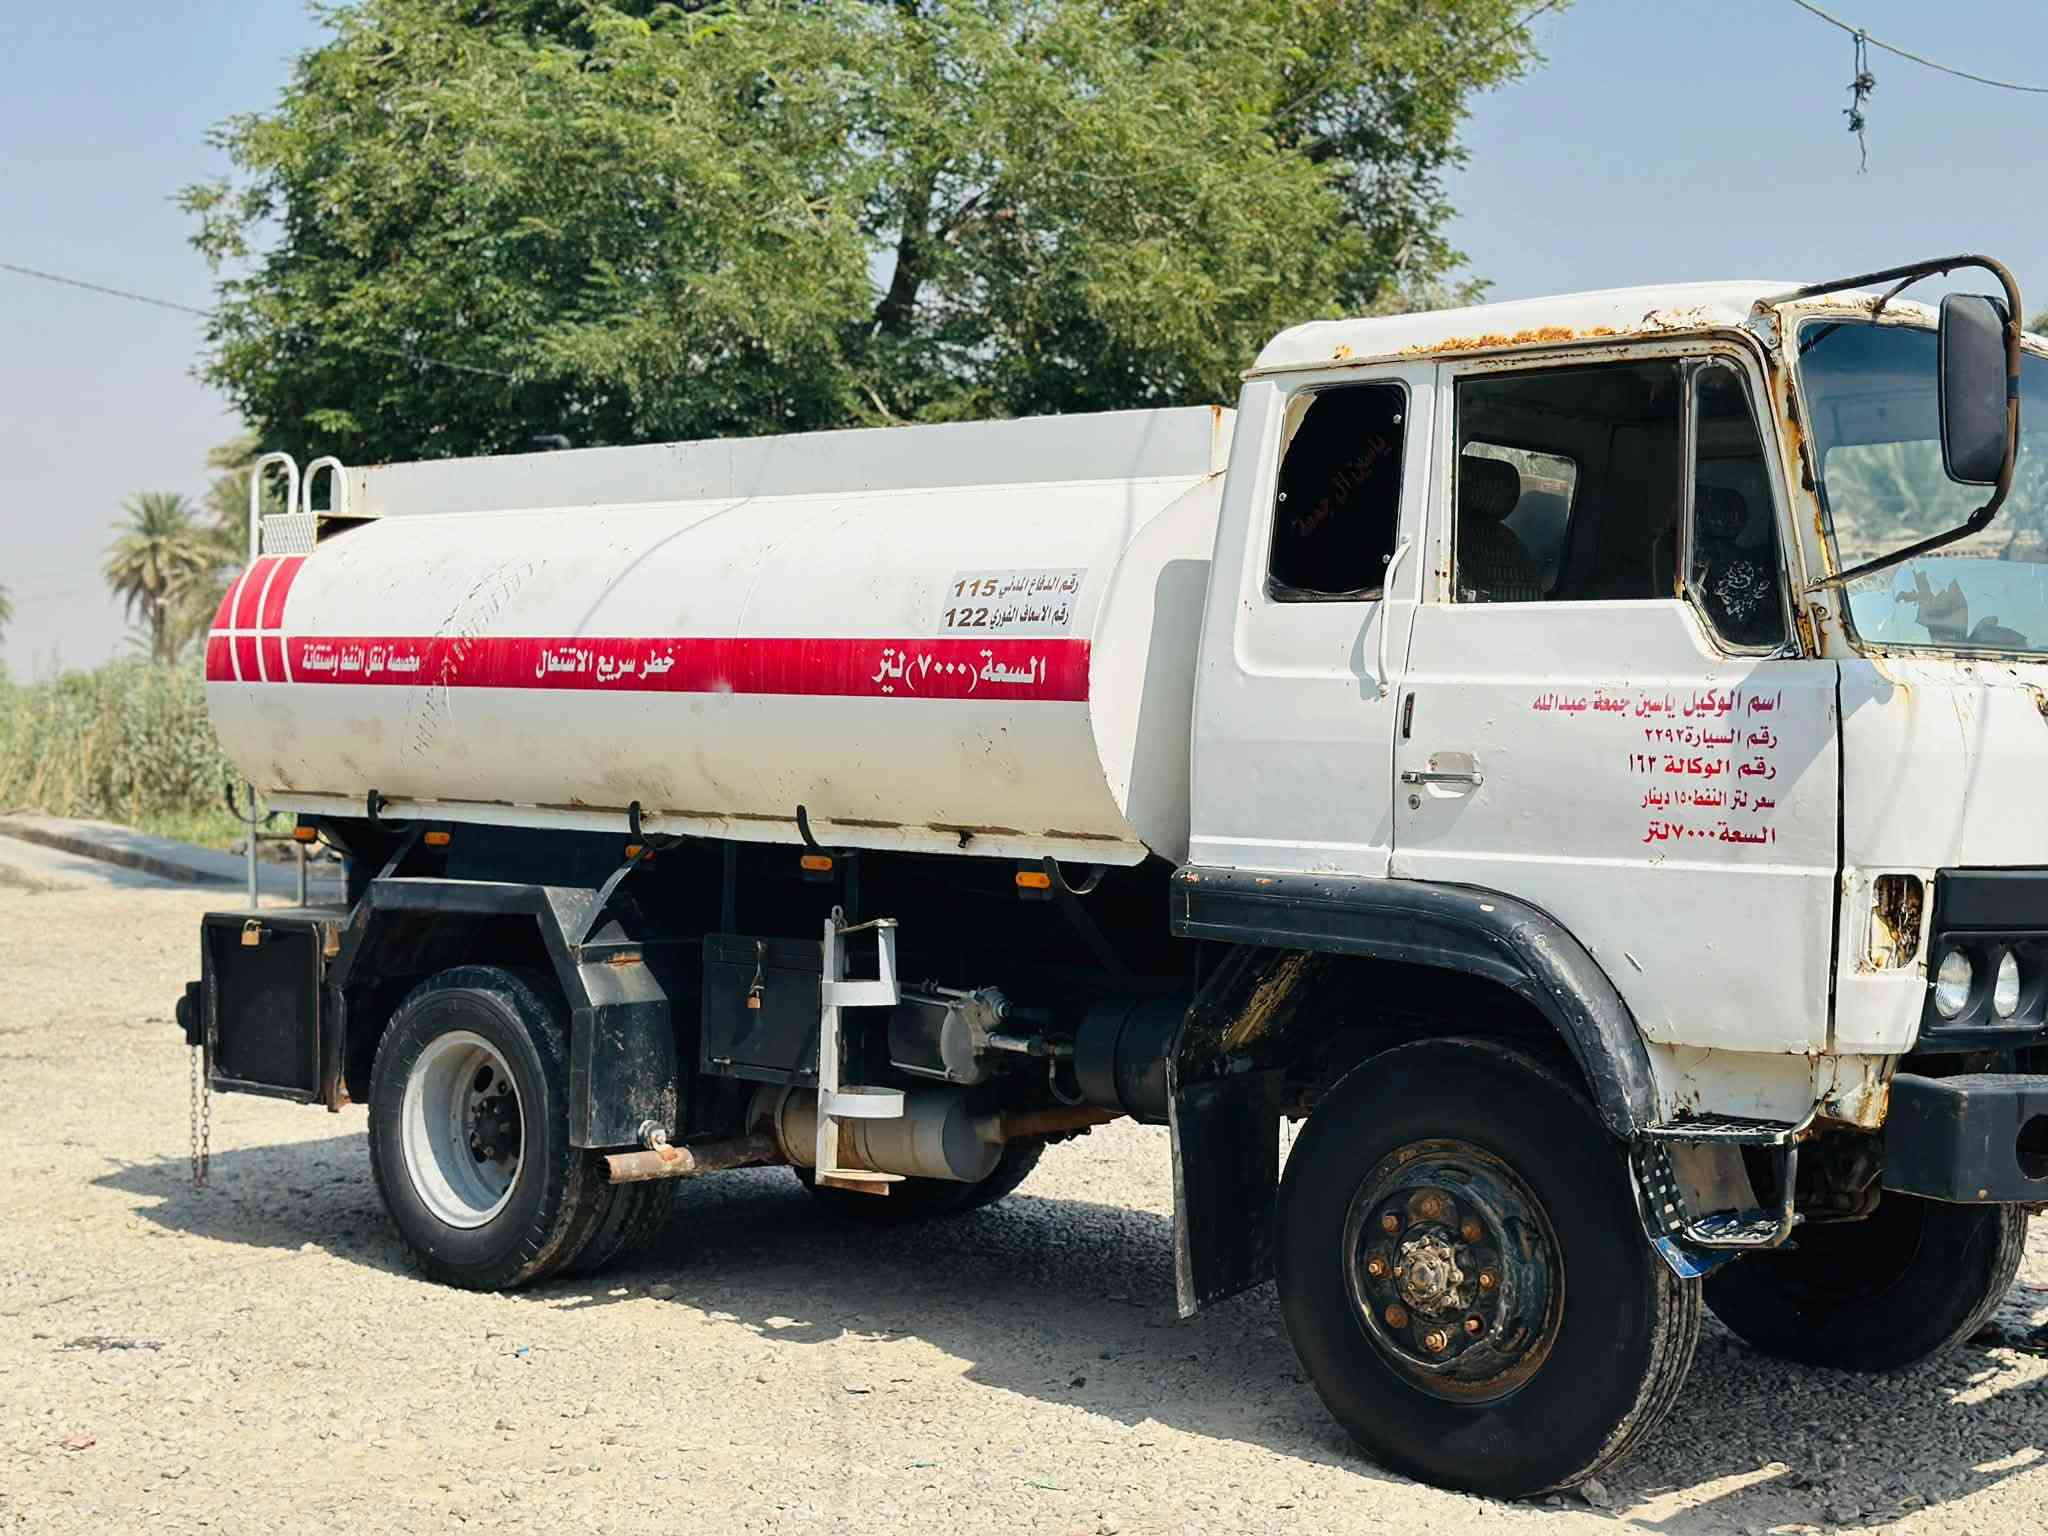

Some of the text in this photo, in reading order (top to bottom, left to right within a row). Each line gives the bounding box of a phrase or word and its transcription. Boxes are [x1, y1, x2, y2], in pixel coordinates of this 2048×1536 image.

[954, 579, 999, 597] 115
[1059, 574, 1079, 594] رقم
[945, 607, 989, 627] 122
[1051, 603, 1069, 625] رقم
[536, 647, 675, 682] خطر سريع الاشتعال
[1592, 690, 1631, 717] جمعة
[1635, 691, 1676, 718] ياسين
[1683, 688, 1742, 718] الوكيل
[1747, 689, 1782, 717] اسم
[1746, 726, 1778, 749] رقم
[1663, 755, 1731, 779] الوكالة
[1738, 756, 1776, 780] رقم
[1641, 786, 1670, 811] دينار
[1730, 791, 1748, 811] لتر
[1752, 795, 1776, 813] سعر
